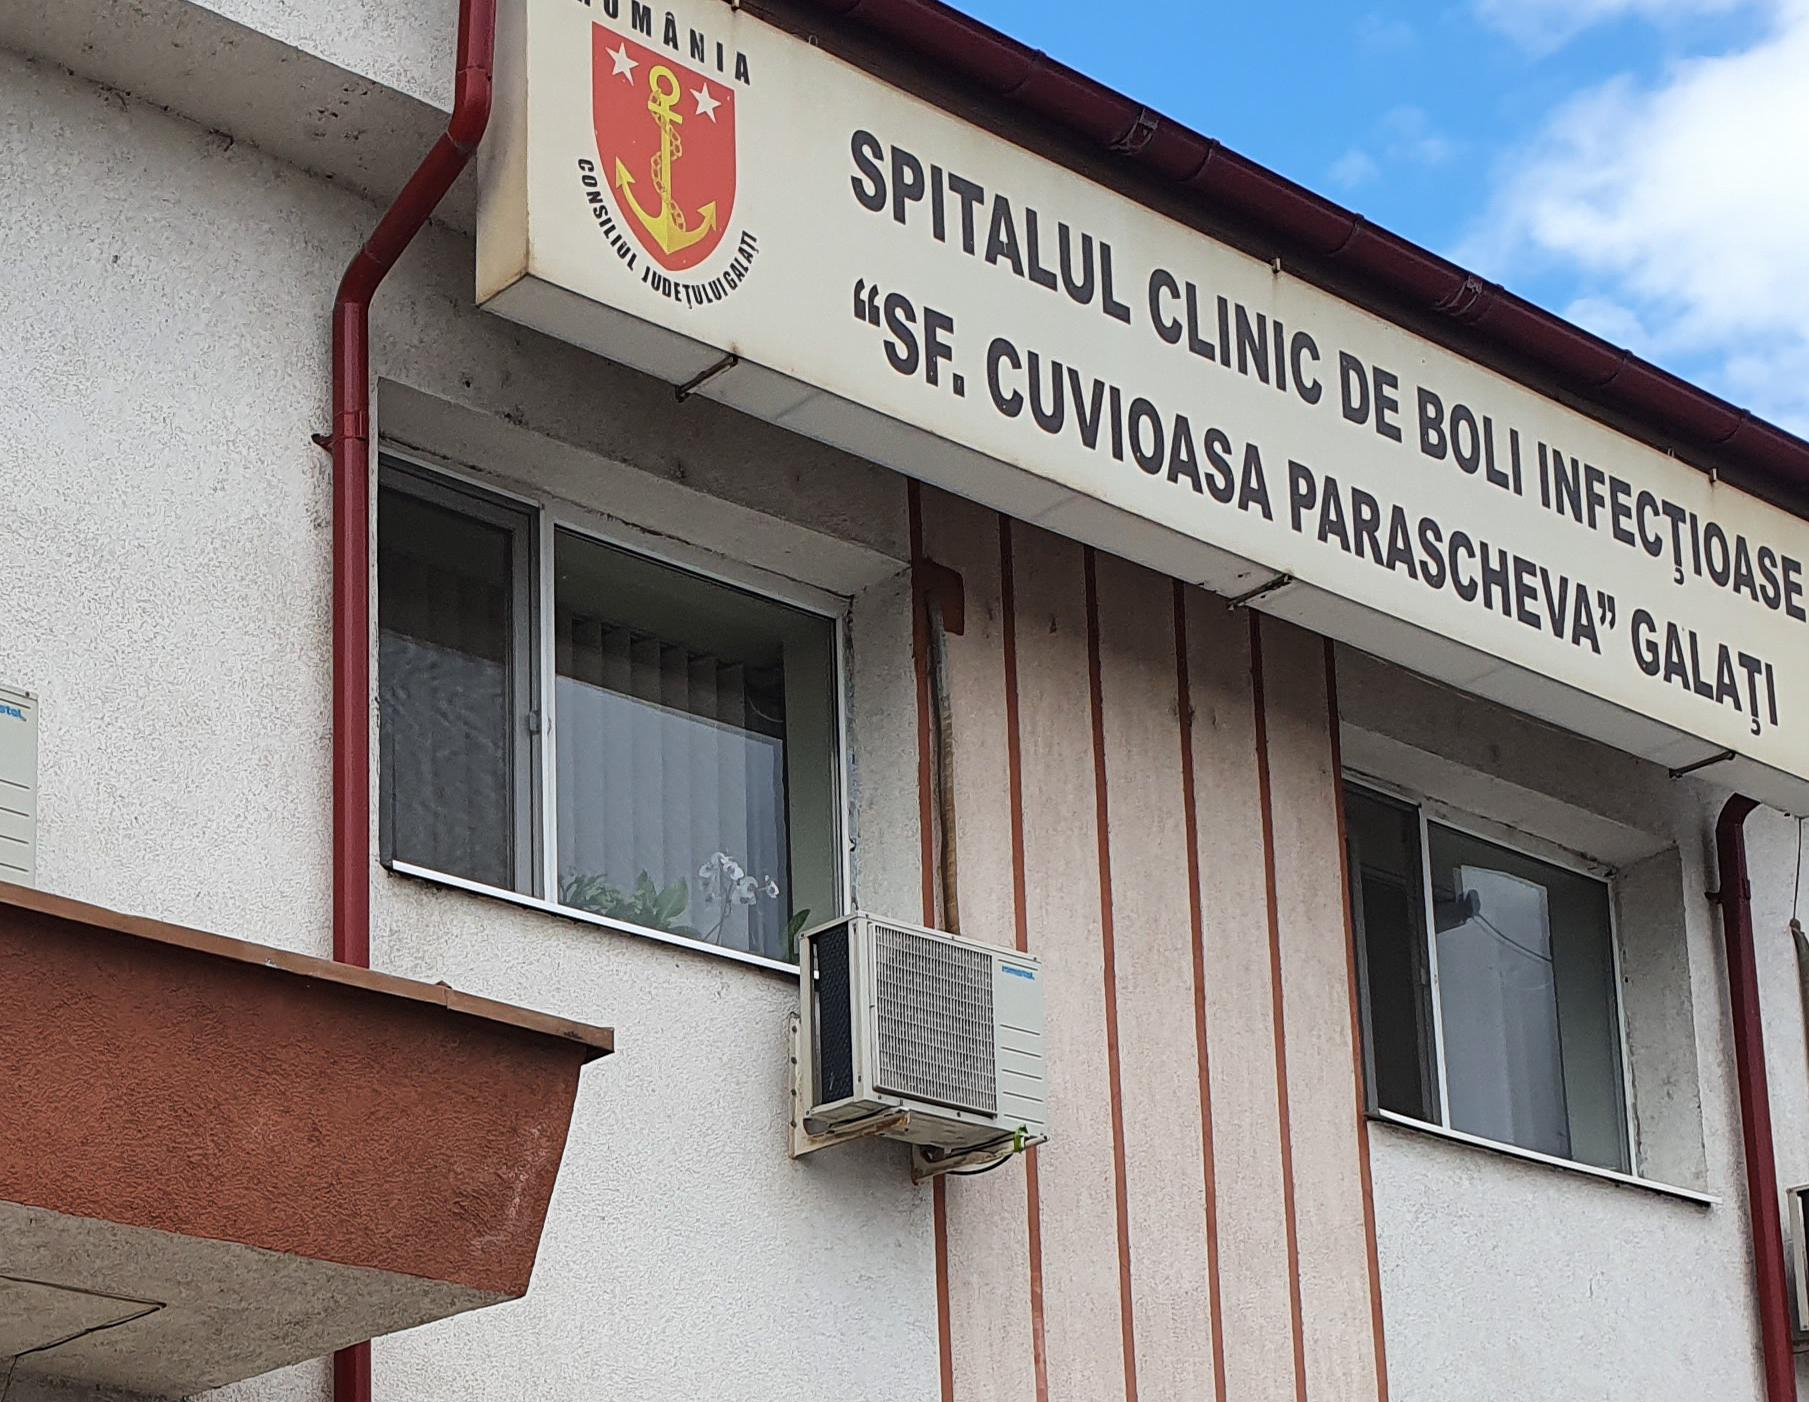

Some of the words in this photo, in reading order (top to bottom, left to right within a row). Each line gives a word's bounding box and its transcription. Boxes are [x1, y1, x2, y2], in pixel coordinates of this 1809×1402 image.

[573, 0, 751, 86] OMÂNIA
[577, 158, 639, 272] CONSILIUL
[850, 129, 1131, 325] SPITALUL
[1148, 267, 1323, 405] CLINIC
[1339, 350, 1403, 444] DE
[1417, 385, 1524, 496] BOLI
[987, 337, 1274, 522] CUVIOASA
